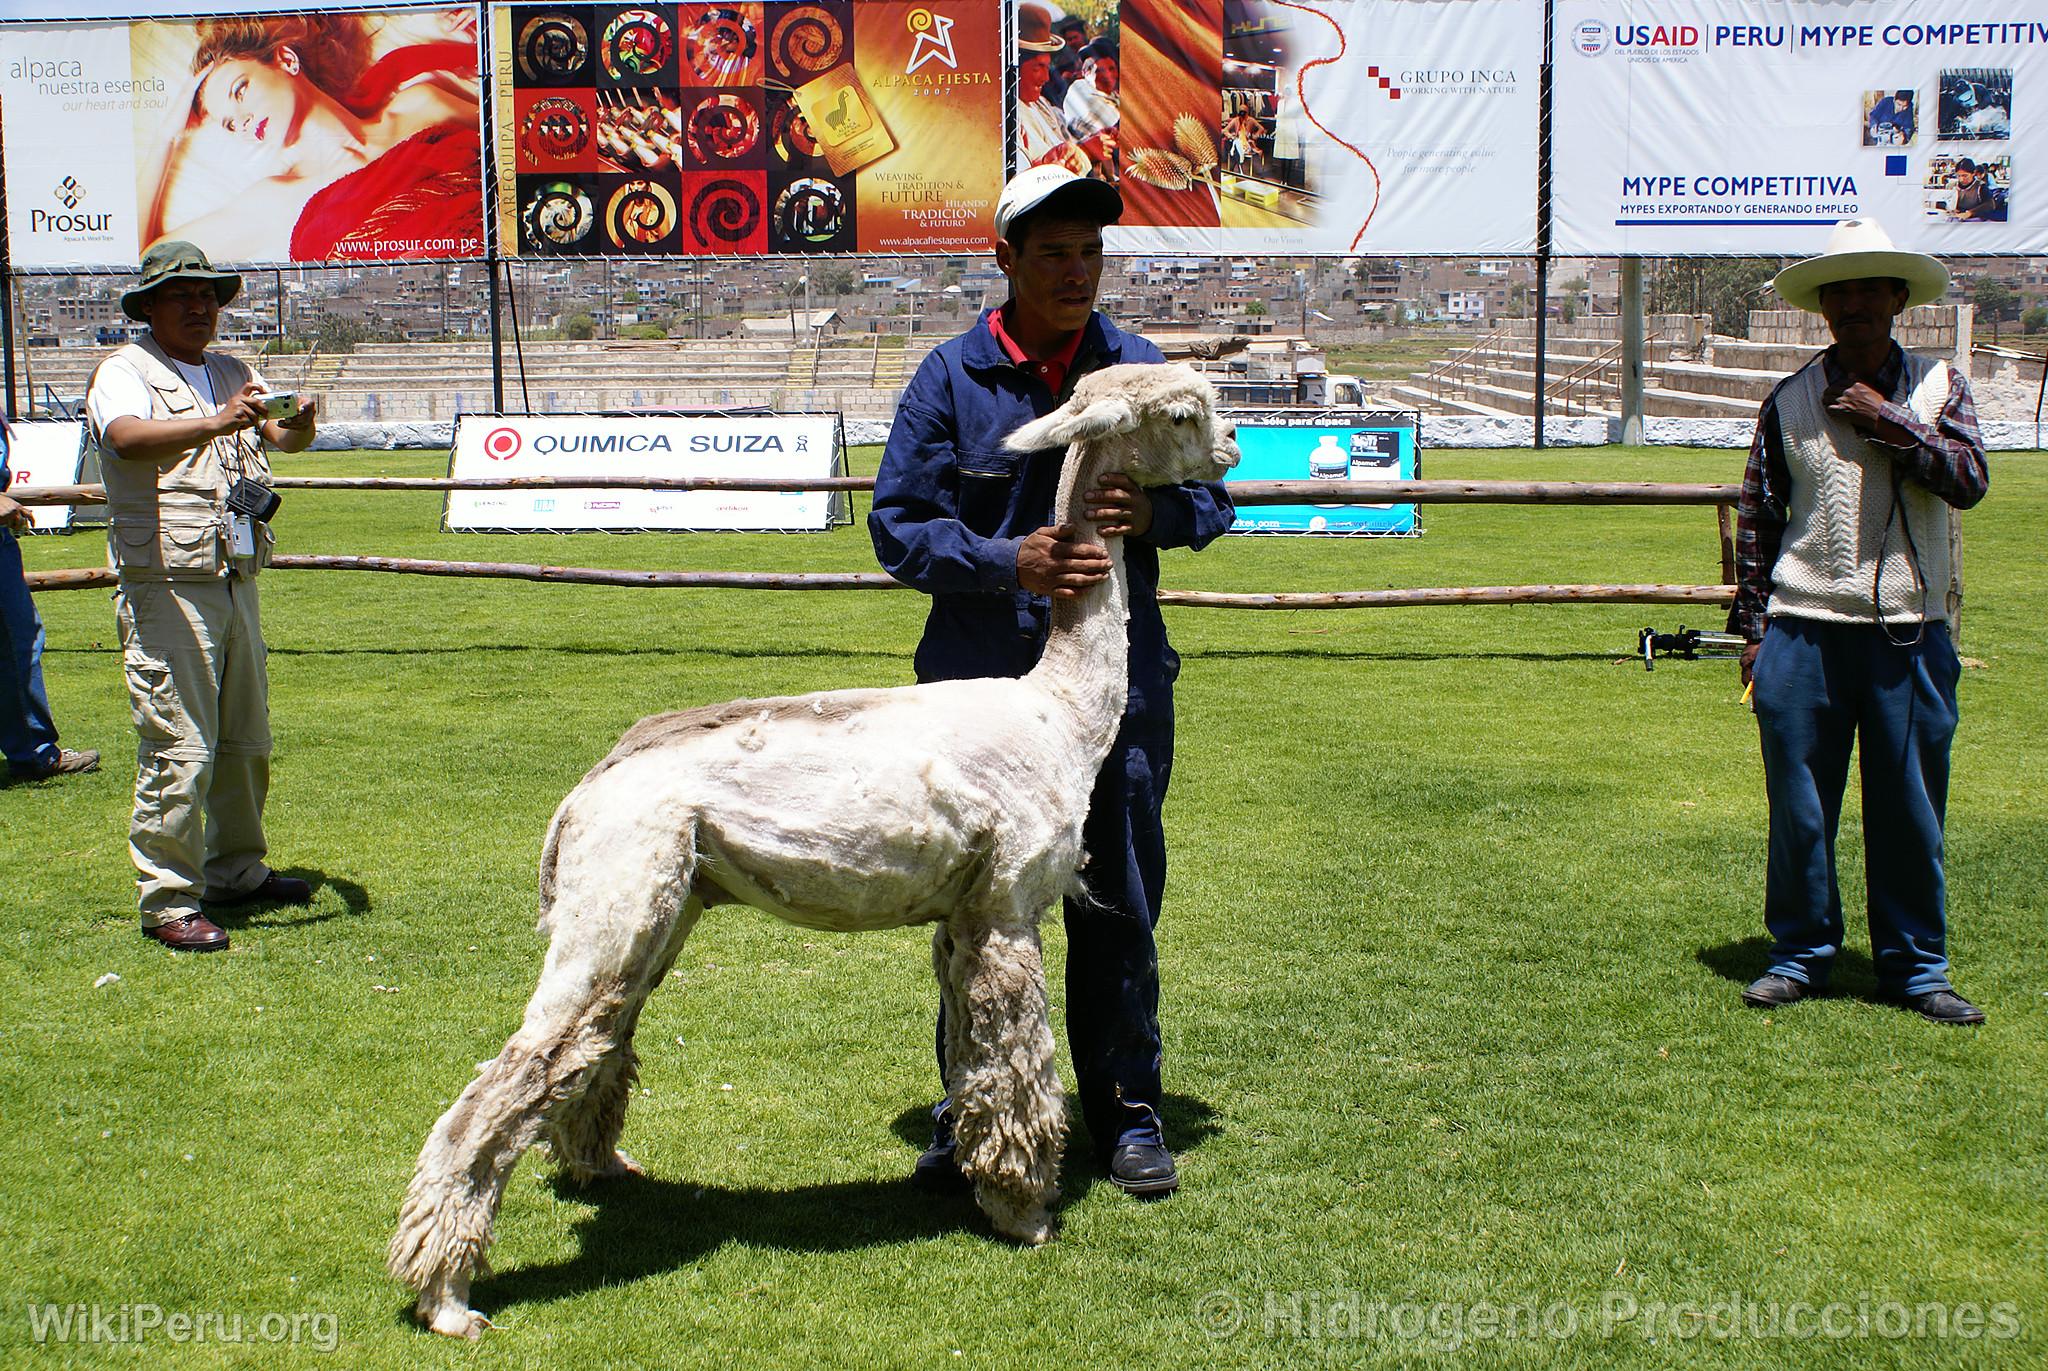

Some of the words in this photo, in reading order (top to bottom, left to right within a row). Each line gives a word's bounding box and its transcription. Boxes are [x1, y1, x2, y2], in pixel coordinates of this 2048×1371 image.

[1615, 25, 1699, 46] USAID
[1716, 26, 1784, 46] PERU
[1800, 26, 1873, 46] MYPE
[10, 56, 82, 83] alpaca
[499, 51, 513, 98] PERU
[873, 74, 933, 88] ALPACA
[938, 72, 992, 85] FIESTA
[1400, 70, 1464, 84] GRUPO
[1471, 70, 1516, 84] INCA
[39, 80, 99, 95] nuestra
[104, 76, 164, 93] esencia
[913, 88, 952, 96] 2007
[1402, 87, 1448, 95] WORKING
[1478, 86, 1517, 94] NATURE
[62, 101, 82, 112] our
[86, 99, 116, 111] heart
[118, 98, 140, 110] and
[143, 97, 168, 109] soul
[1386, 147, 1416, 159] People
[1418, 148, 1468, 160] generating
[501, 121, 517, 218] AREQUIPA
[1403, 163, 1418, 176] for
[875, 173, 923, 182] WEAVING
[896, 181, 953, 190] TRADITION
[956, 180, 964, 190] &
[1622, 176, 1686, 196] MYPE
[1694, 176, 1858, 196] COMPETITIVA
[882, 190, 943, 202] FUTURE
[945, 200, 989, 208] HILANDO
[1620, 204, 1655, 214] MYPES
[1658, 204, 1734, 214] EXPORTANDO
[1734, 204, 1740, 214] Y
[1744, 204, 1812, 214] GENERANDO
[1816, 204, 1858, 214] EMPLEO
[902, 206, 977, 220] TRADICIÓN
[31, 209, 112, 232] Prosur
[920, 219, 928, 228] &
[930, 220, 966, 228] FUTURO
[879, 236, 989, 246] www.alpacafiestaperu.com
[1264, 236, 1278, 244] Our
[1280, 235, 1303, 244] Vision
[335, 238, 478, 256] www.prosur.com.pe
[1288, 418, 1313, 427] para
[1315, 418, 1351, 427] alpaca
[533, 434, 672, 455] QUIMICA
[690, 435, 784, 453] SUIZA
